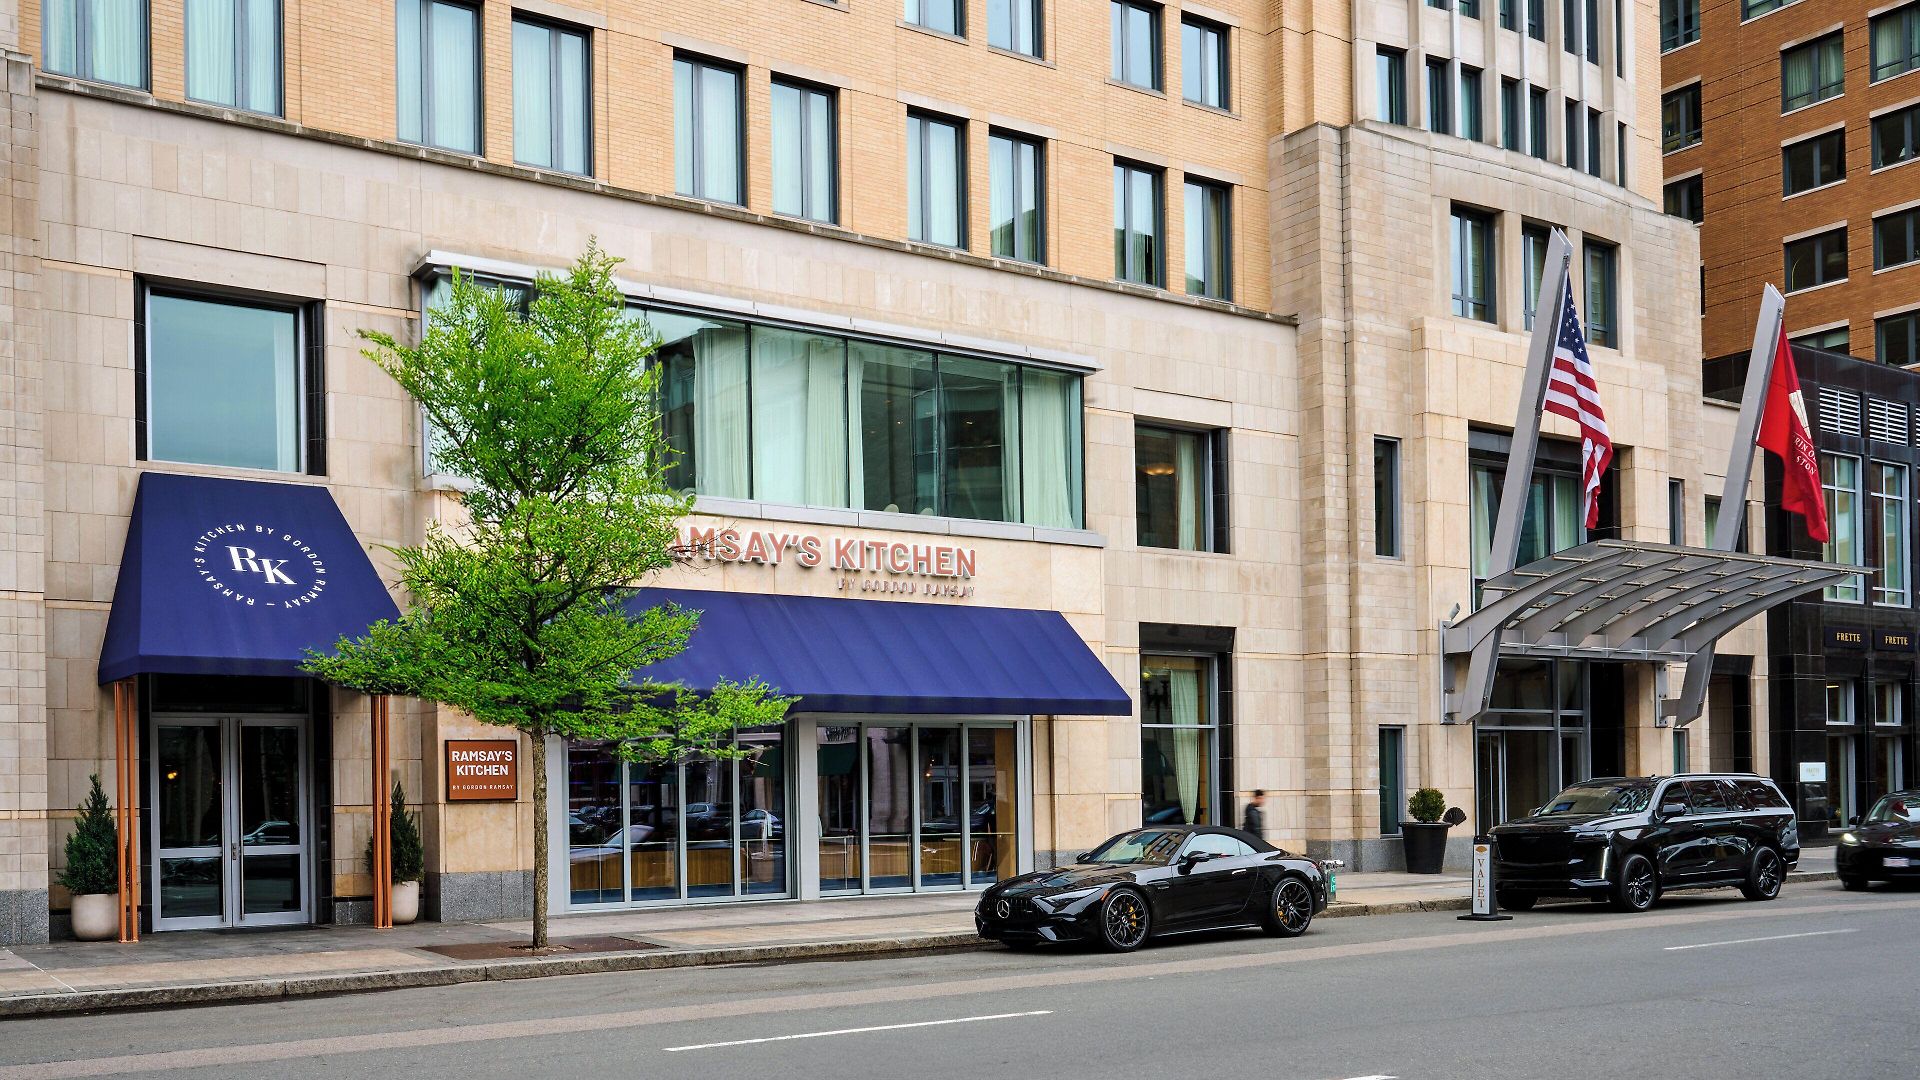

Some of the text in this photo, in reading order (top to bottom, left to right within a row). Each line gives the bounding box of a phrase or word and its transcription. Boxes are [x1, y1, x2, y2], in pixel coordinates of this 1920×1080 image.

[1796, 455, 1817, 475] STON
[665, 524, 977, 578] AMSAY'S KITCHEN
[194, 523, 327, 609] RAMSAY'S KITCHEN BY GORDON RAMSAY
[225, 545, 298, 585] RK
[862, 579, 917, 594] GORDON
[923, 583, 975, 598] RAMSAY
[1836, 631, 1861, 643] FRETTE
[1884, 635, 1909, 646] FRETTE
[451, 750, 513, 762] RAMSAY'S
[456, 764, 509, 776] KITCHEN
[1477, 858, 1485, 908] VALET
